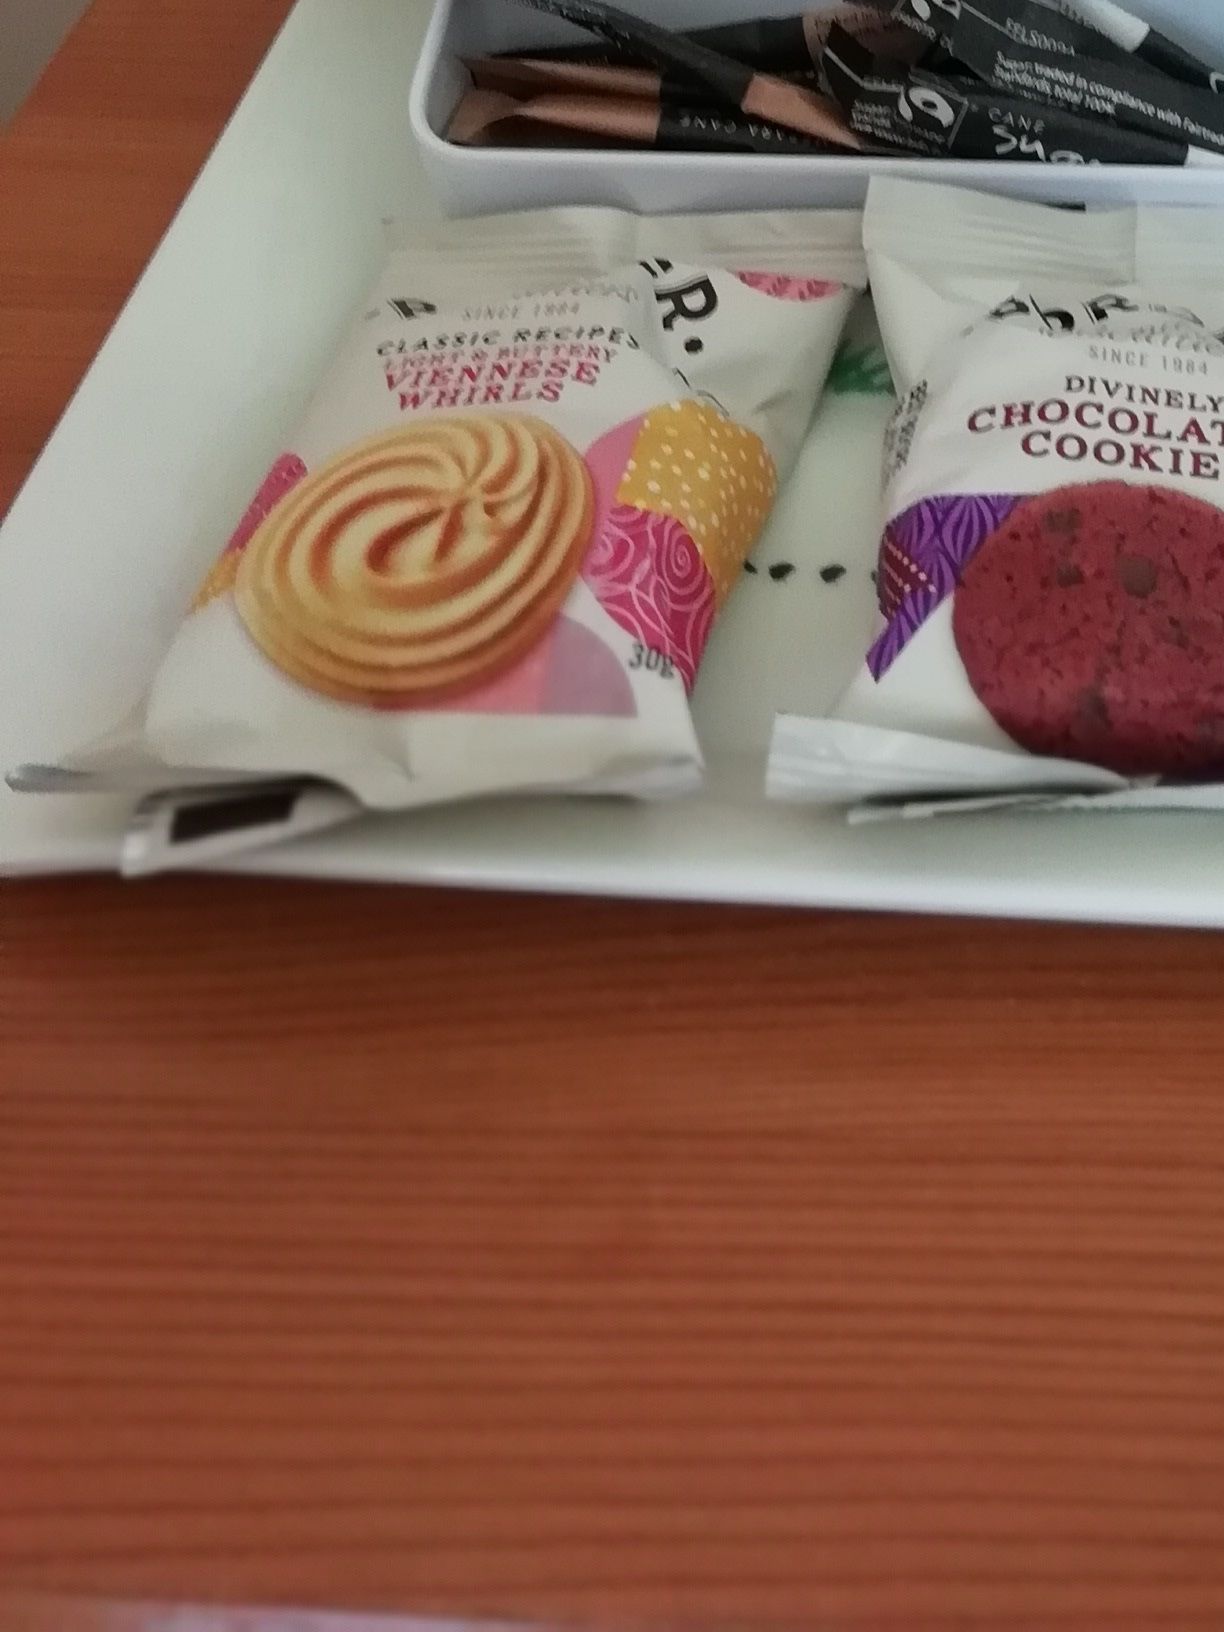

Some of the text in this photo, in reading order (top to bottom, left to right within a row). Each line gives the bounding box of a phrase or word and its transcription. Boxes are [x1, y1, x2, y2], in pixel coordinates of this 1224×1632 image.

[376, 329, 502, 358] CLASSIC
[1087, 343, 1151, 367] SINCE
[384, 360, 601, 392] VIENNESE
[400, 380, 565, 412] WHIRLS
[628, 641, 676, 680] 30g
